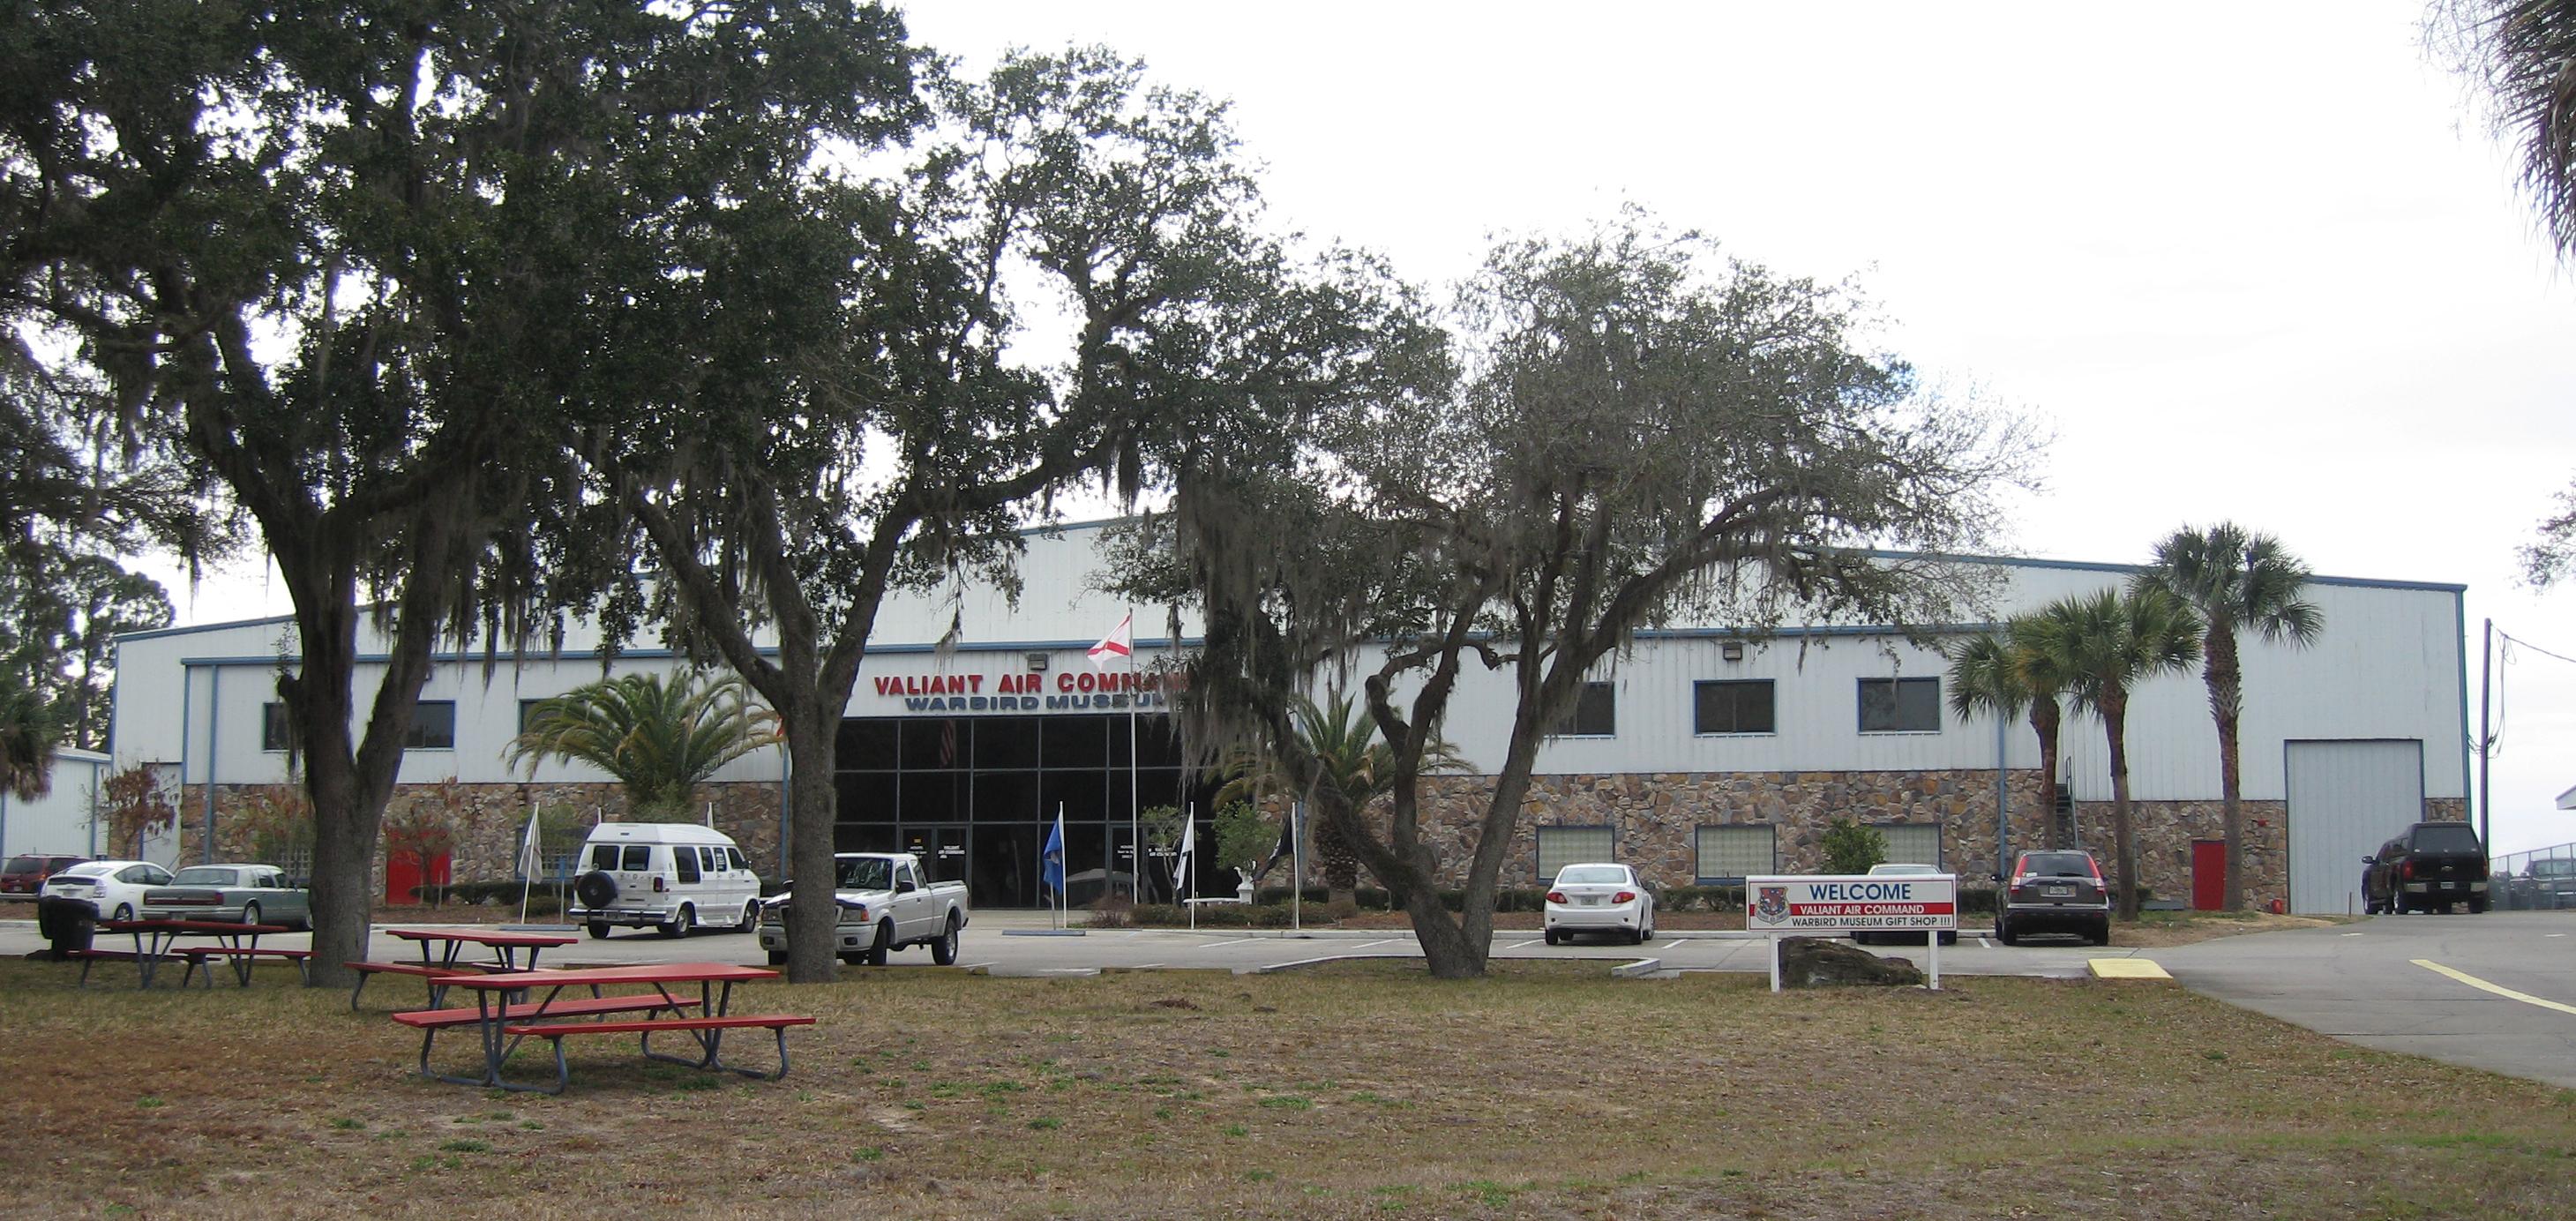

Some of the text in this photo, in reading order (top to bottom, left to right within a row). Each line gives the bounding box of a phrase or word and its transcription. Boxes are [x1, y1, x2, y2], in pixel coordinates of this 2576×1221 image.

[874, 675, 983, 695] VALIANT
[998, 674, 1042, 693] AIR
[904, 696, 1039, 711] WARBIRD
[1809, 883, 1911, 900] WELCOME
[1800, 904, 1924, 915] VALIANT AIR COMMAND
[1840, 917, 1883, 926] MUSEUM
[1885, 917, 1907, 926] GIFT
[1910, 917, 1937, 926] SHOP
